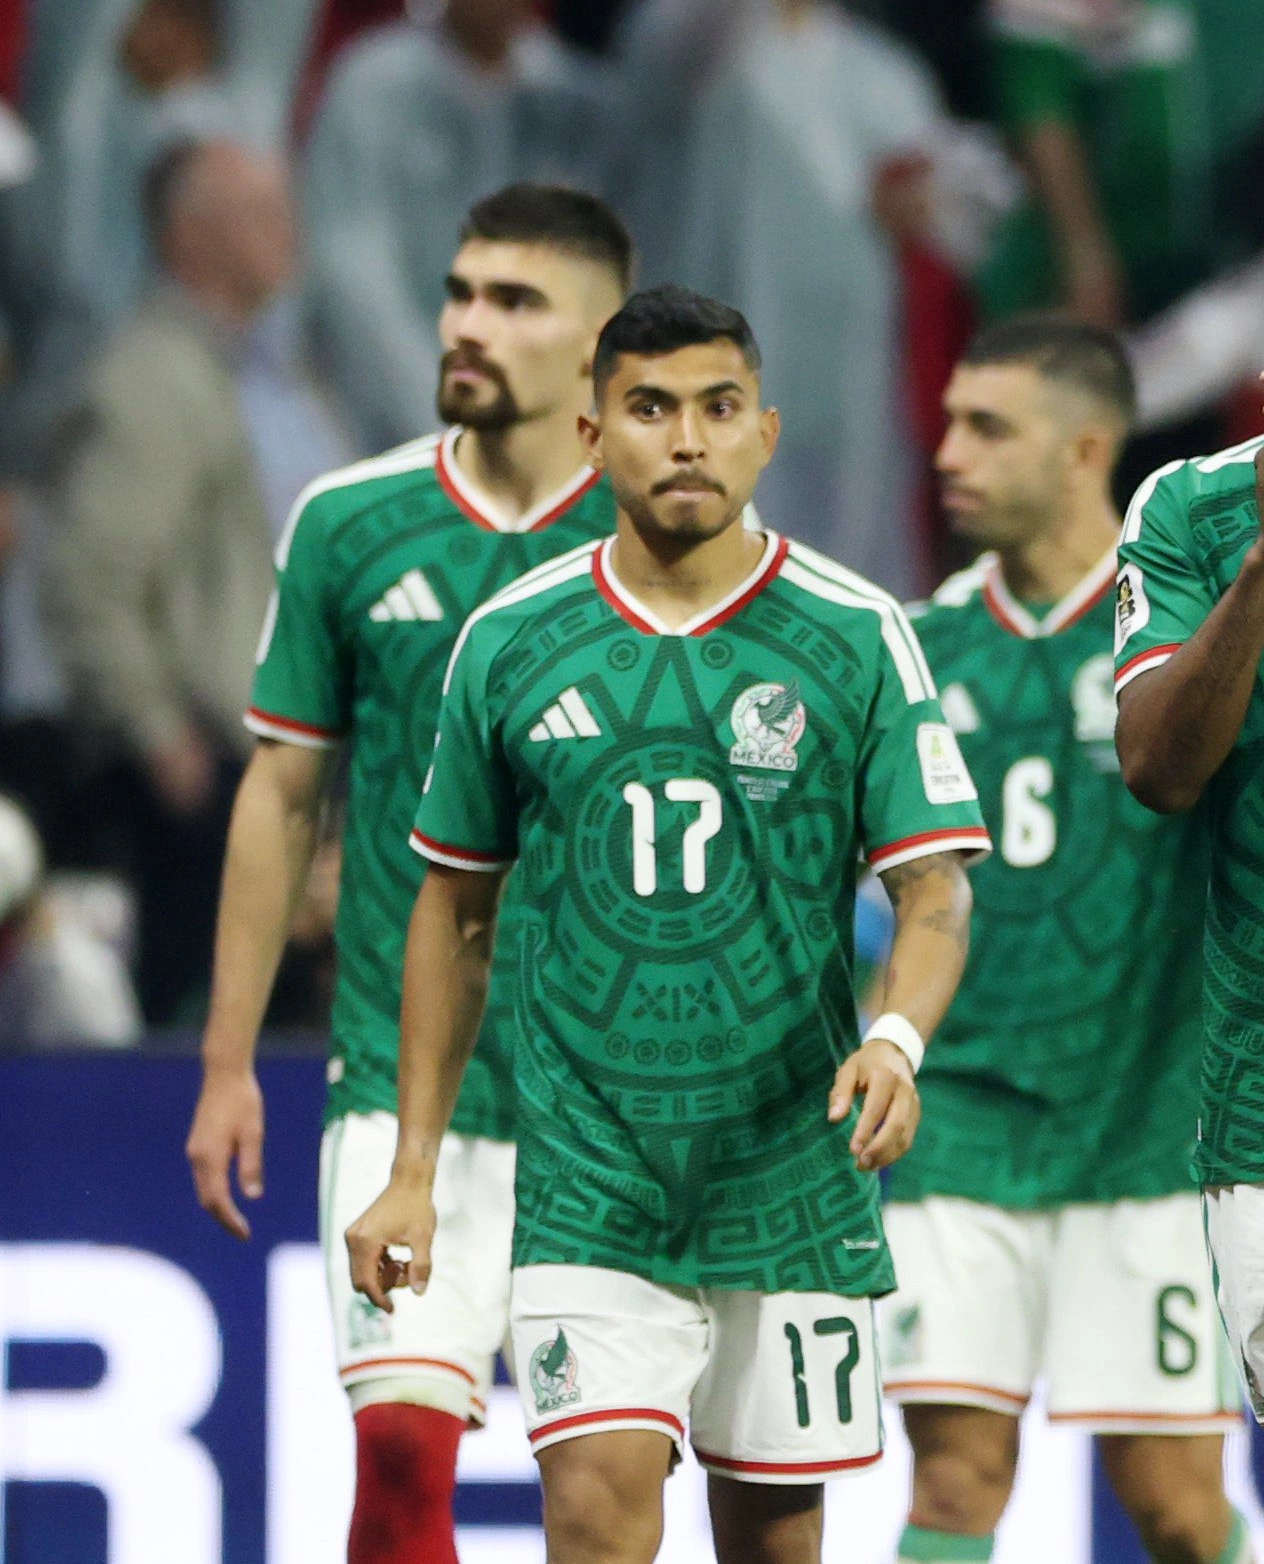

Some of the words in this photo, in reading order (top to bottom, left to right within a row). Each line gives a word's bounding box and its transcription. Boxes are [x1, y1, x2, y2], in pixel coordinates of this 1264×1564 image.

[624, 779, 723, 897] 17
[1002, 757, 1056, 867] 6
[784, 1316, 860, 1428] 17
[1157, 1284, 1198, 1376] 6
